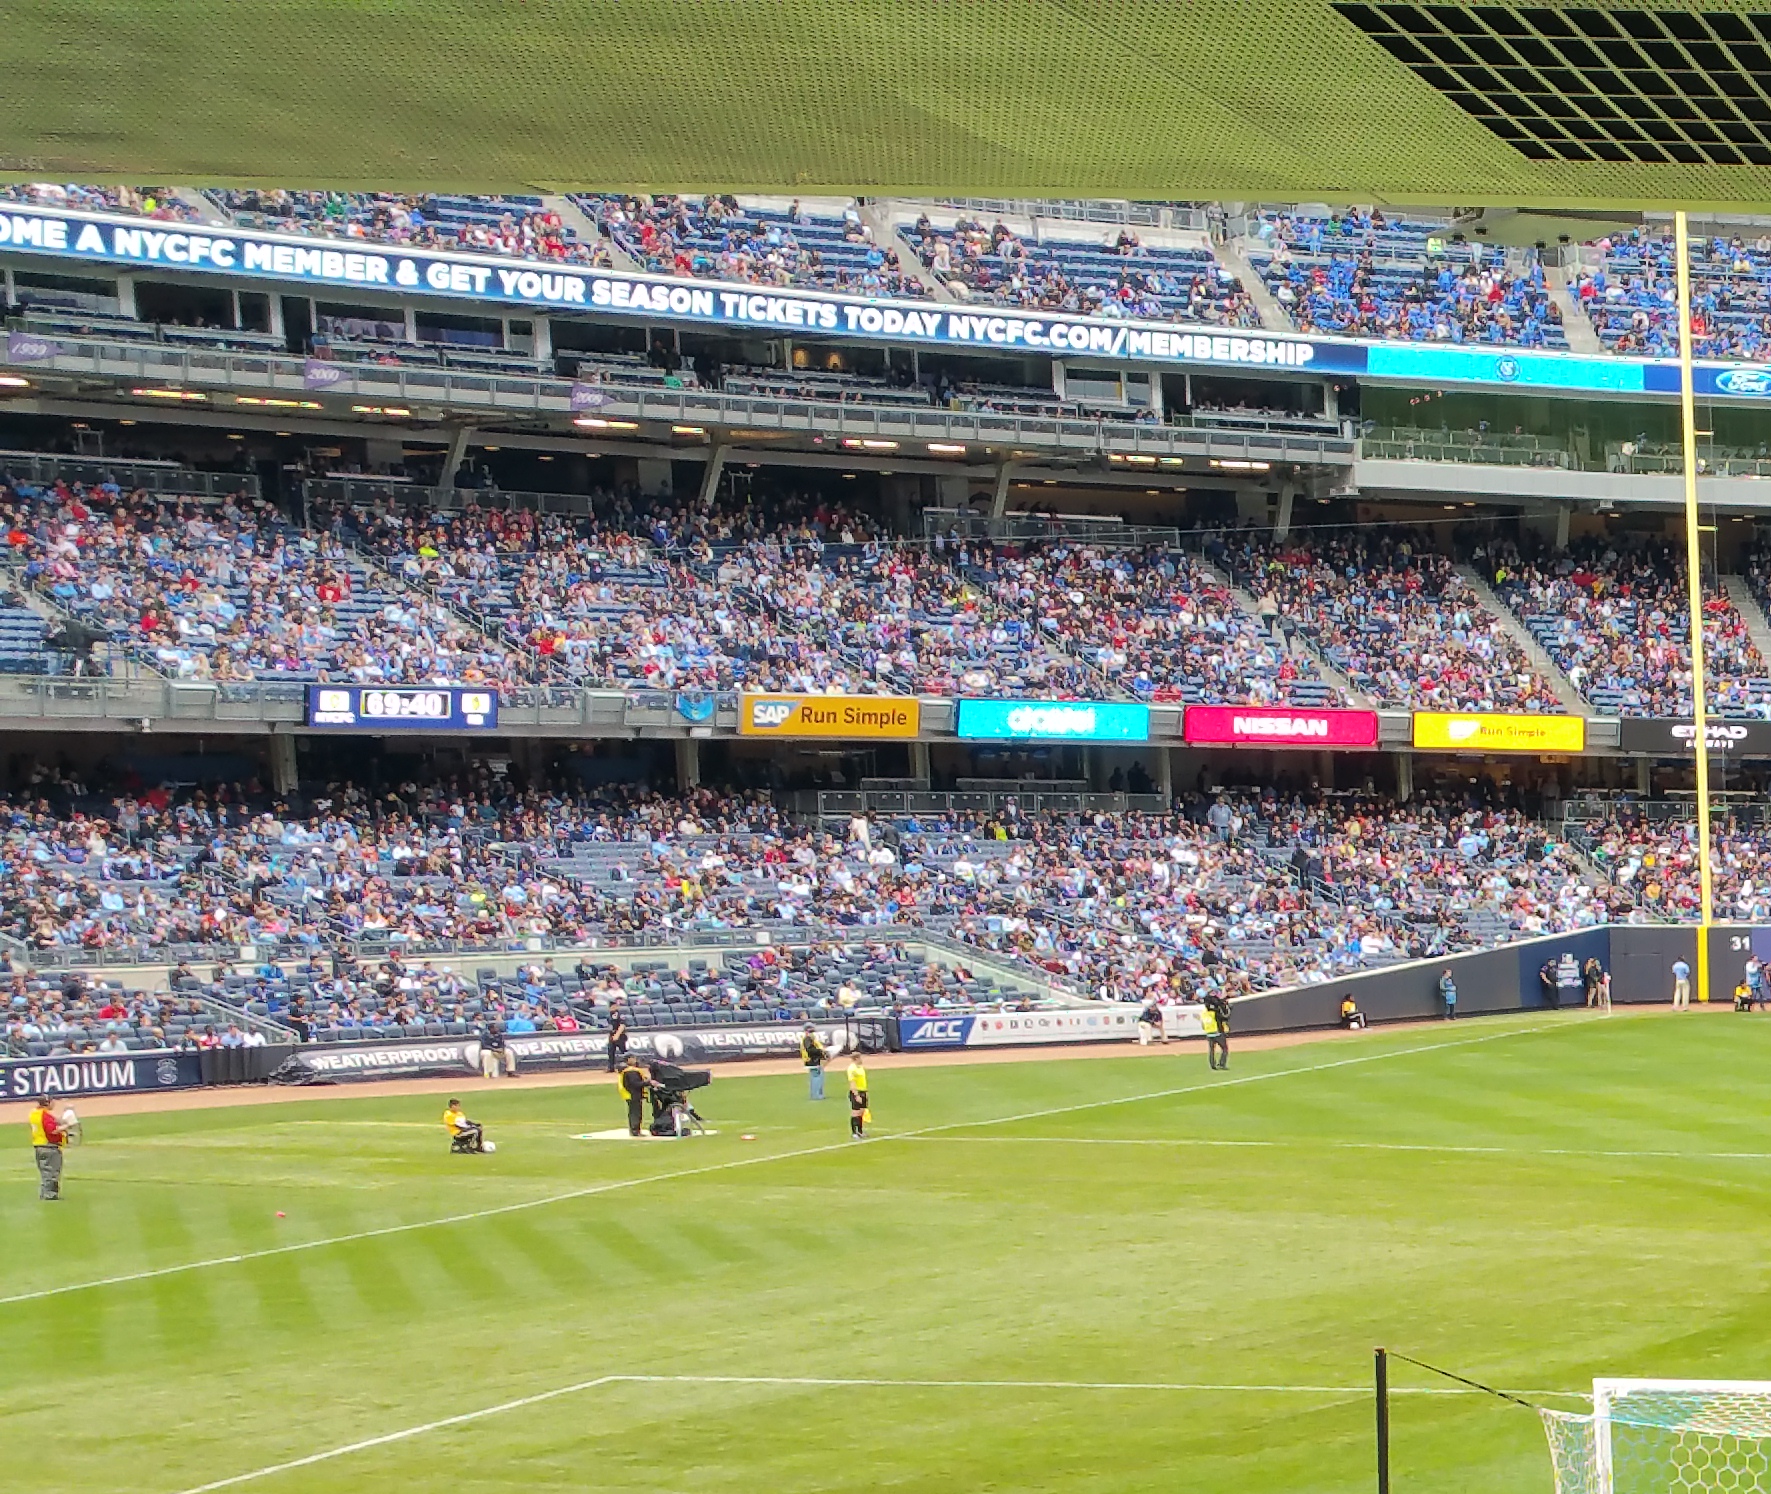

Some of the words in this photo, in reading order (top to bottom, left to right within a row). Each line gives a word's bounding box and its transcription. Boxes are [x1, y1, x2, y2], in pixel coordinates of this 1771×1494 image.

[76, 225, 106, 253] A
[114, 228, 236, 268] NYCFC
[244, 242, 388, 284] MEMBER
[396, 259, 419, 286] &
[427, 262, 492, 293] GET
[498, 269, 586, 304] YOUR
[592, 280, 714, 316] SEASON
[719, 293, 837, 328] TICKETS
[844, 305, 942, 340] TODAY
[948, 314, 1314, 366] NYCFC.COM/MEMBERSHIP
[367, 692, 442, 716] 69:40
[753, 704, 790, 723] SAP
[801, 707, 838, 724] Run
[844, 707, 907, 728] Simple
[1233, 717, 1328, 736] NISSAN
[912, 1022, 964, 1039] ACC
[13, 1060, 136, 1095] STADIUM
